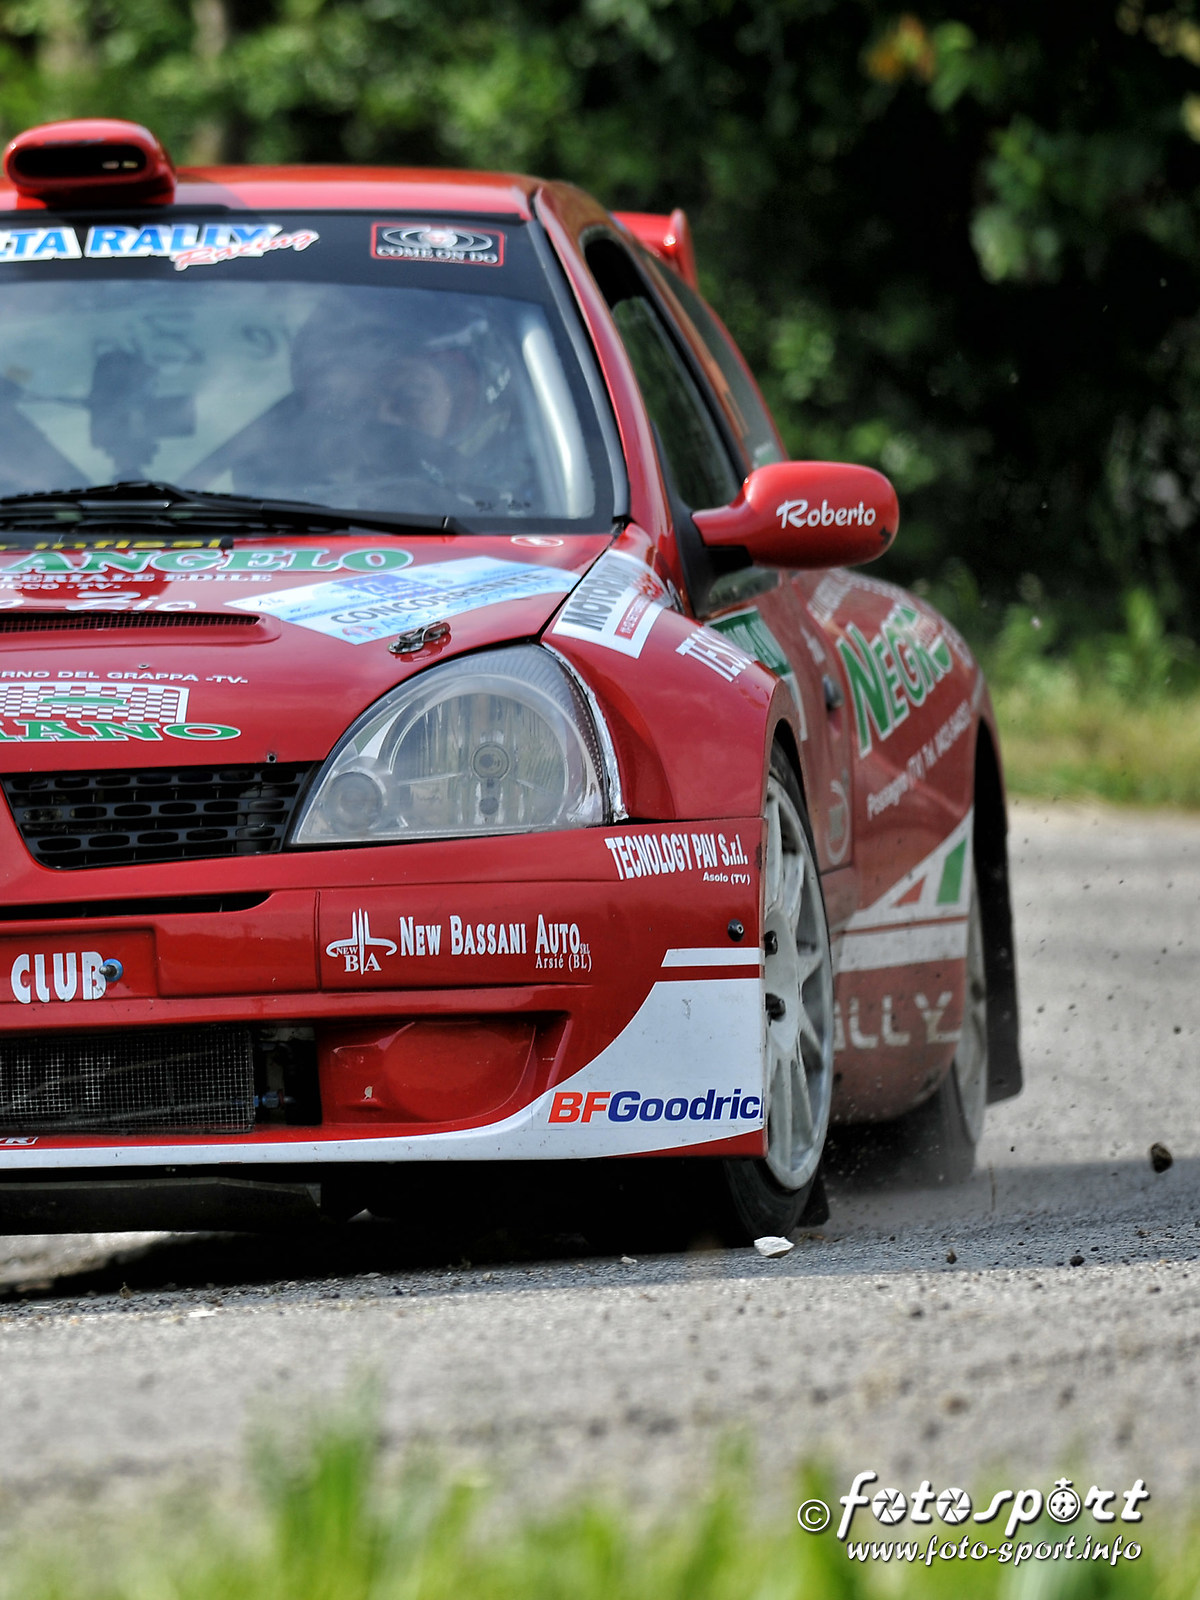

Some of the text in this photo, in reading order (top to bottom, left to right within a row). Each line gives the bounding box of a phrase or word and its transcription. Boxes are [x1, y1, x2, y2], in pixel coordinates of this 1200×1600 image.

[85, 223, 282, 258] RALLY
[376, 246, 433, 259] COME
[435, 249, 465, 261] ON
[469, 252, 498, 264] DO
[775, 499, 876, 529] Roberto
[164, 573, 273, 583] EDILE
[57, 671, 100, 679] DEL
[106, 671, 199, 682] GRAPPA
[604, 833, 749, 880] TECNOLOGY PAV S.r.l.
[703, 871, 751, 886] Asolo (TV)
[400, 916, 442, 956] NEW
[449, 915, 528, 956] BASSANI
[535, 914, 580, 954] AUTO
[535, 953, 593, 973] Arsié (BL)
[10, 951, 107, 1004] CLUB
